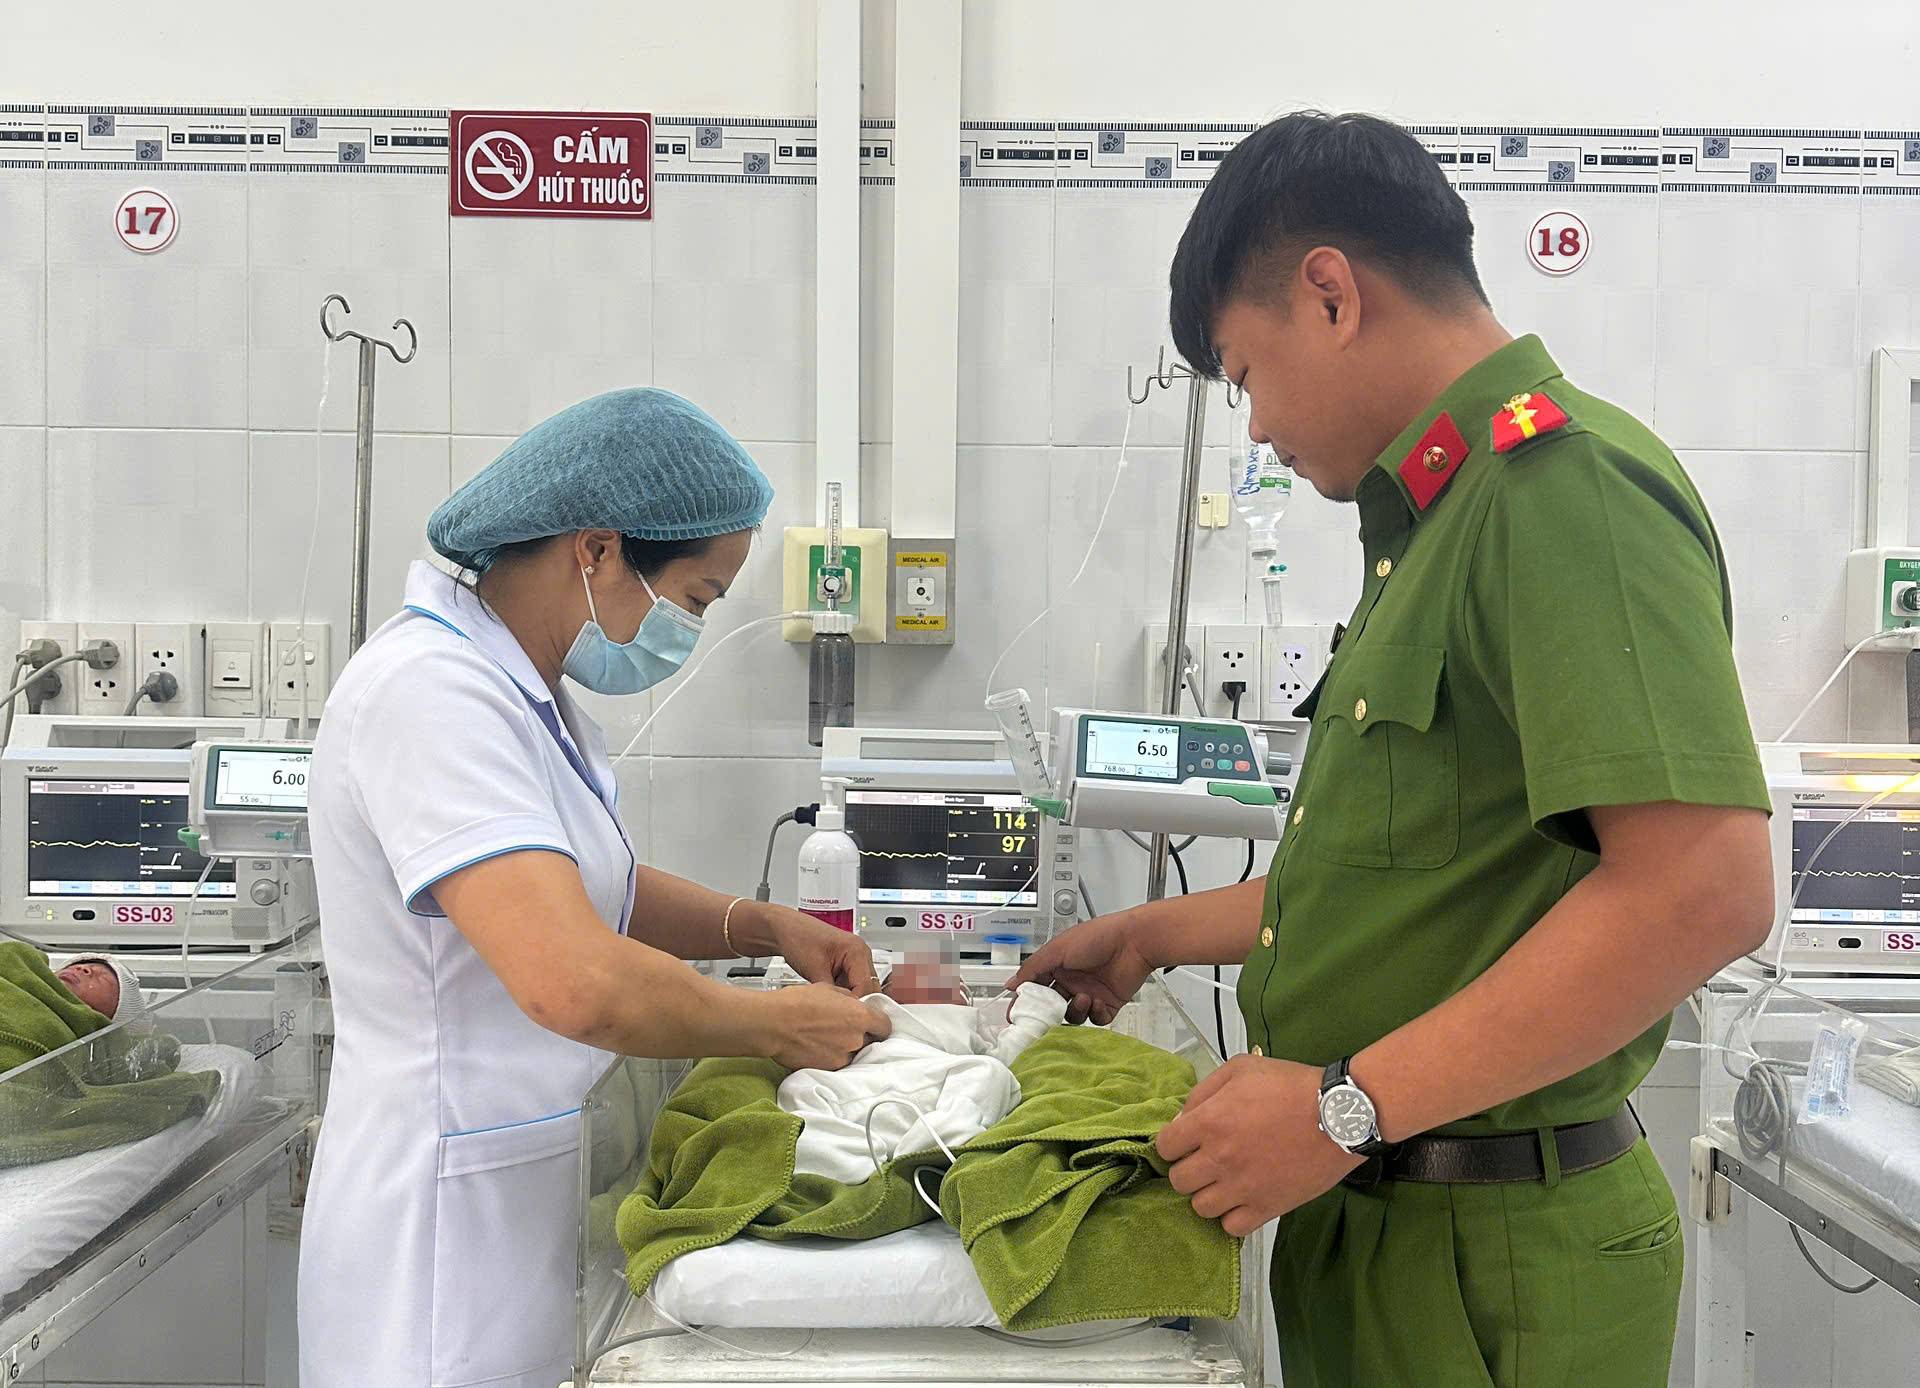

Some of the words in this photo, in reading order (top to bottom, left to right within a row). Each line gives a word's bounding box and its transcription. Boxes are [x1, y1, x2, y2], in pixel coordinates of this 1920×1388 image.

[553, 126, 629, 164] CẤM
[538, 171, 575, 203] HÚT
[580, 168, 645, 205] THUỐC
[124, 206, 167, 235] 17
[1537, 227, 1581, 257] 18
[1137, 740, 1168, 757] 6.50
[272, 769, 306, 786] 6.00
[993, 812, 1027, 830] 114
[1002, 836, 1026, 853] 97
[116, 906, 173, 923] SS-03
